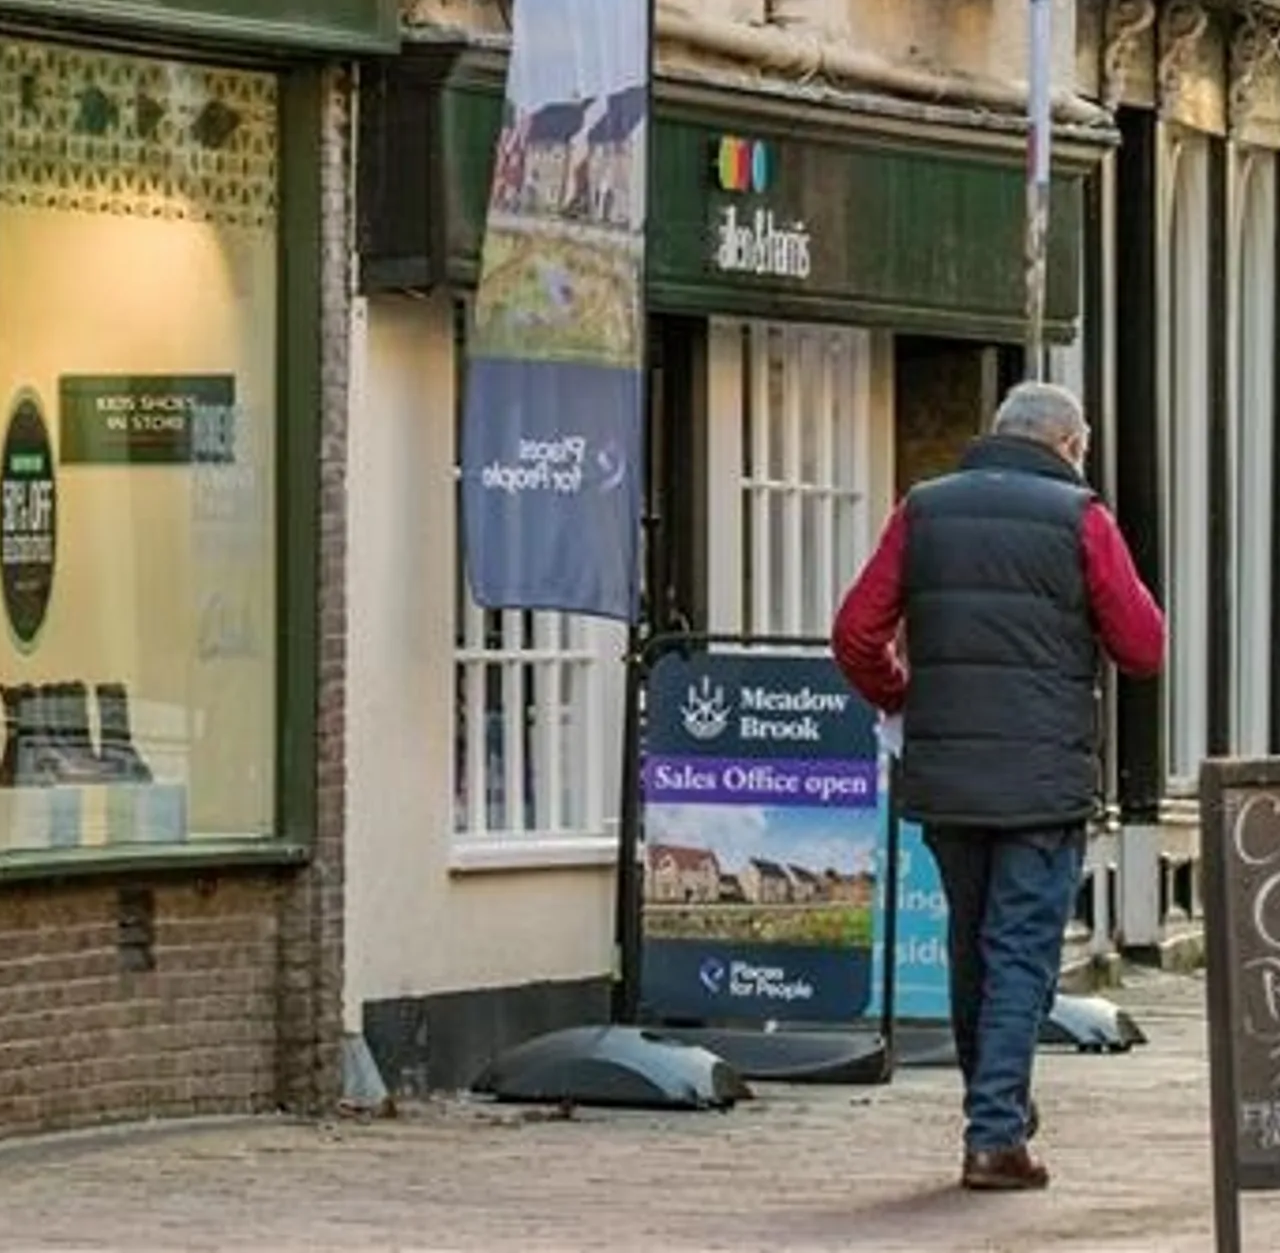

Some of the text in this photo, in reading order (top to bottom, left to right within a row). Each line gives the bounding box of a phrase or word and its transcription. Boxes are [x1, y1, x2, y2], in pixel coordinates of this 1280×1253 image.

[739, 686, 849, 713] Meadow
[739, 716, 821, 741] Brook
[654, 765, 868, 800] Sales Office open
